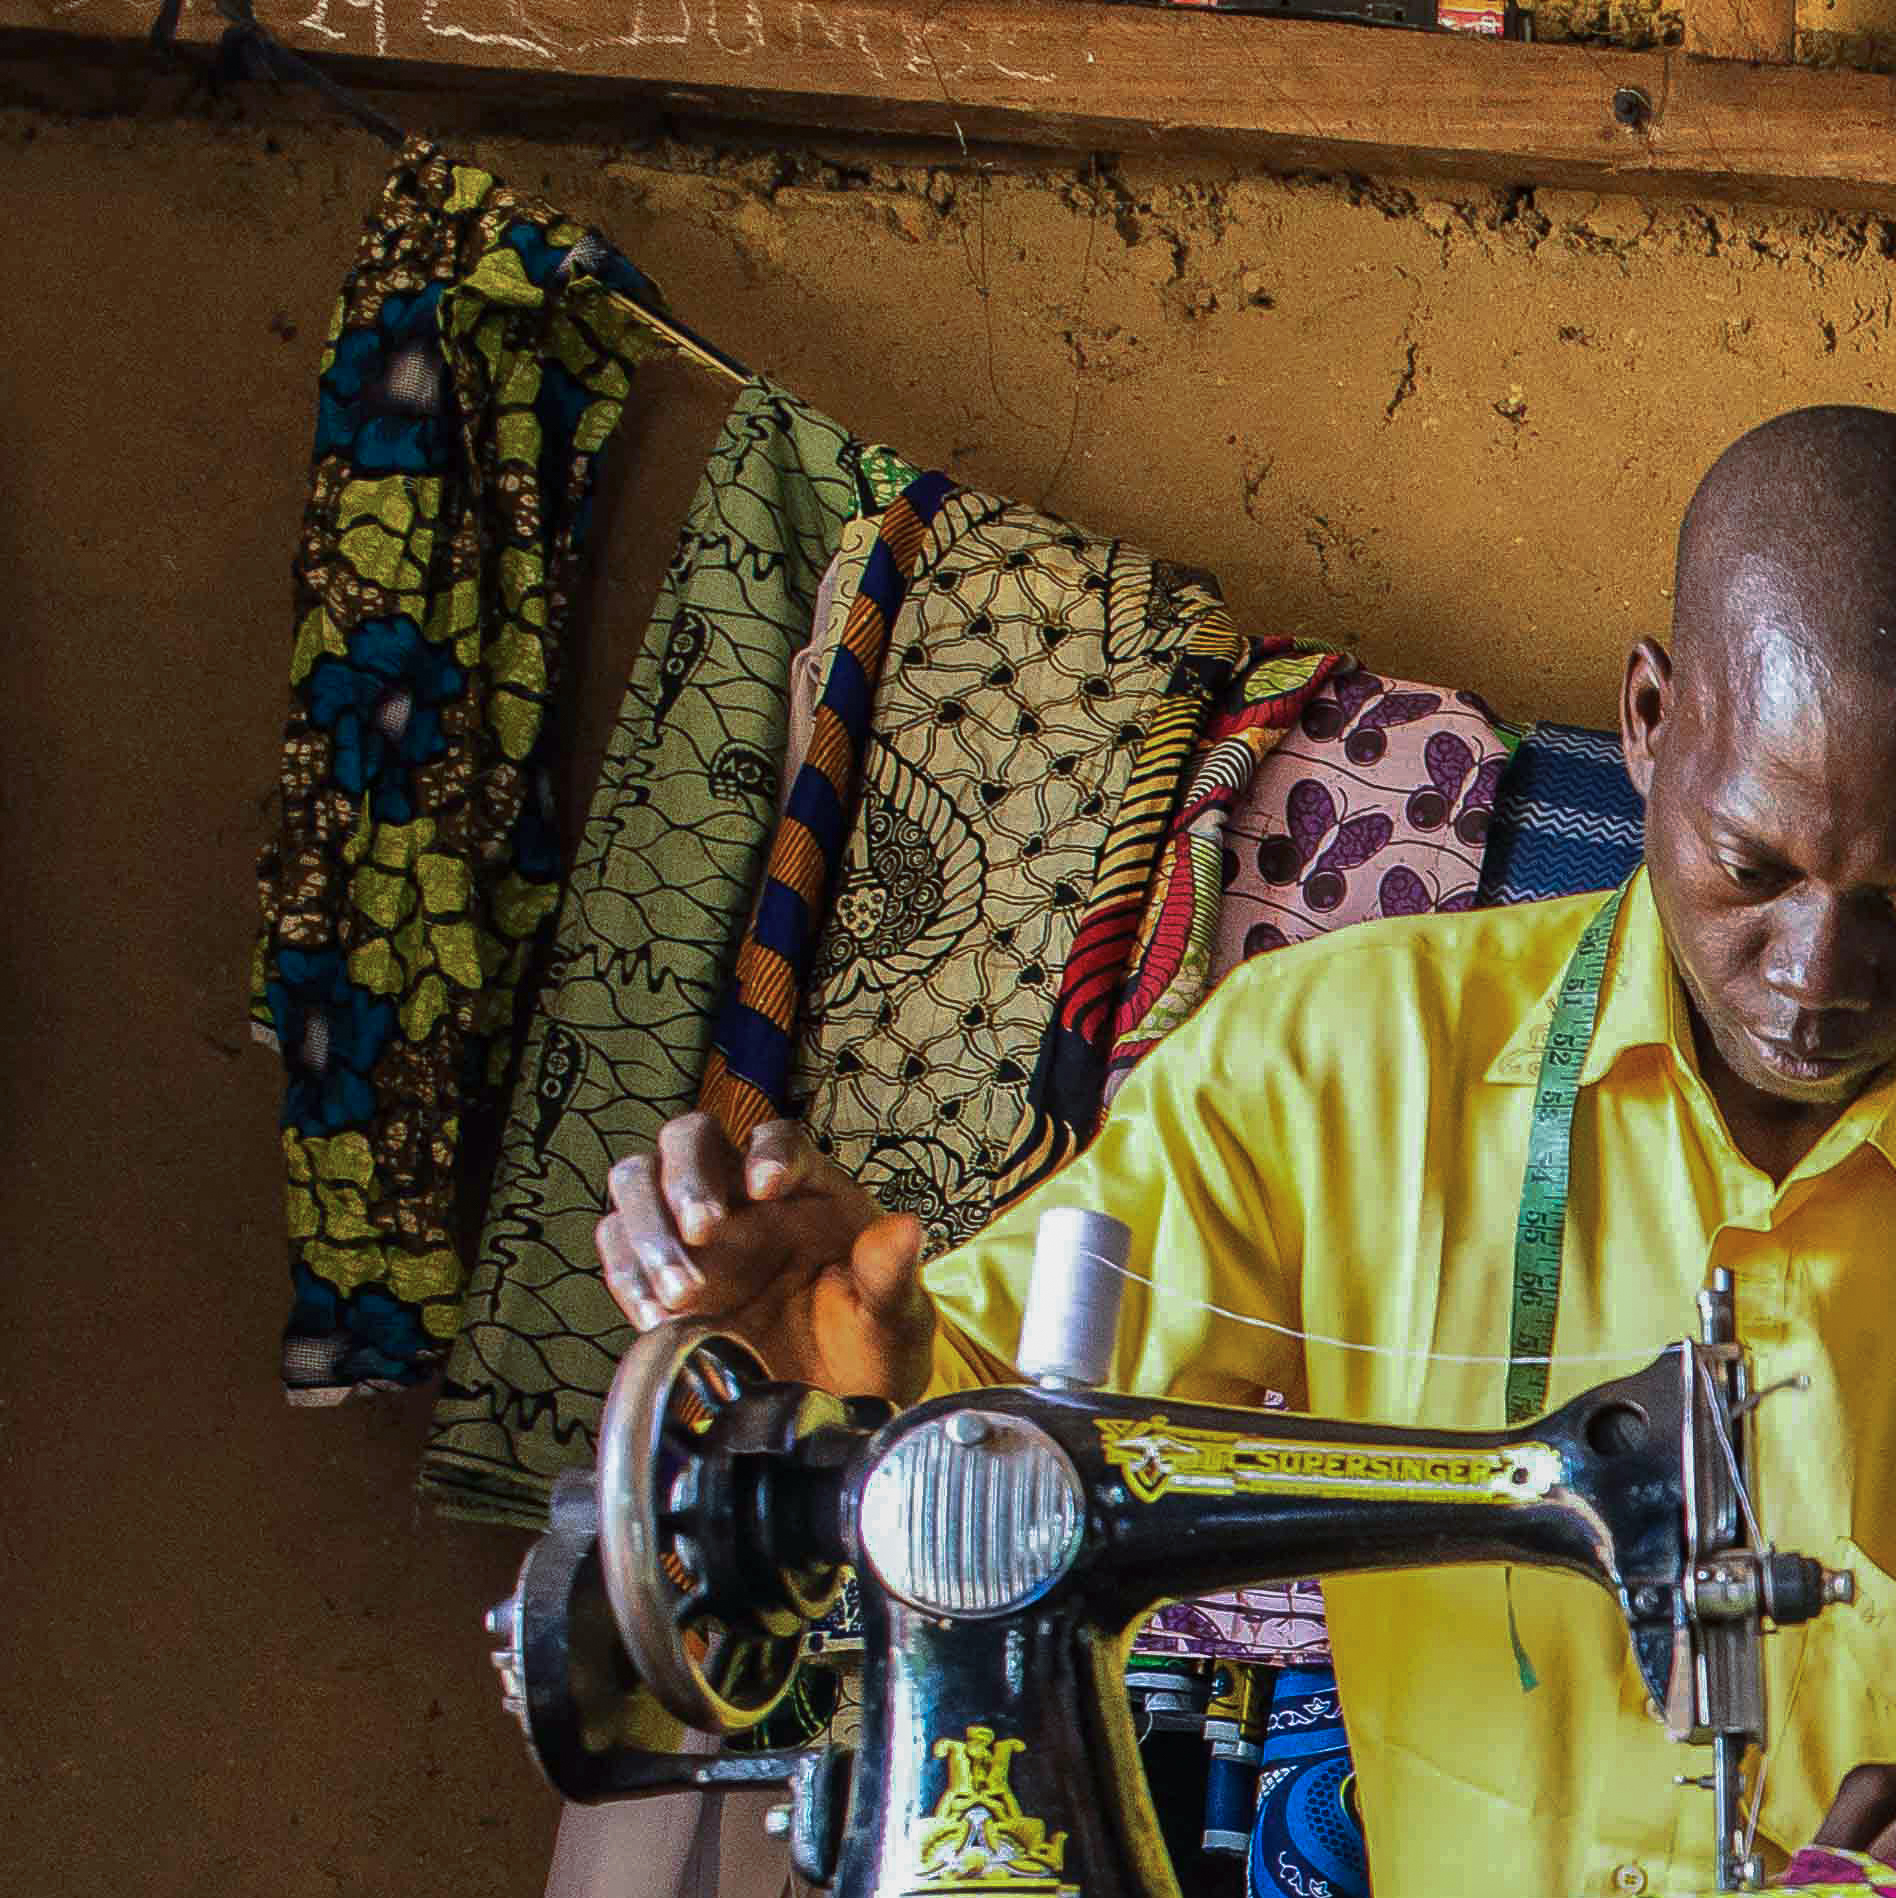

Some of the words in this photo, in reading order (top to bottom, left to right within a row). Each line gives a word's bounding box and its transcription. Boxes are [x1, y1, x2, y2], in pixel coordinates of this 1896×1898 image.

[1561, 978, 1586, 1008] 51
[1549, 1033, 1576, 1066] 52
[1523, 1209, 1549, 1246] 55
[1255, 1448, 1491, 1484] SUPERSINGER
